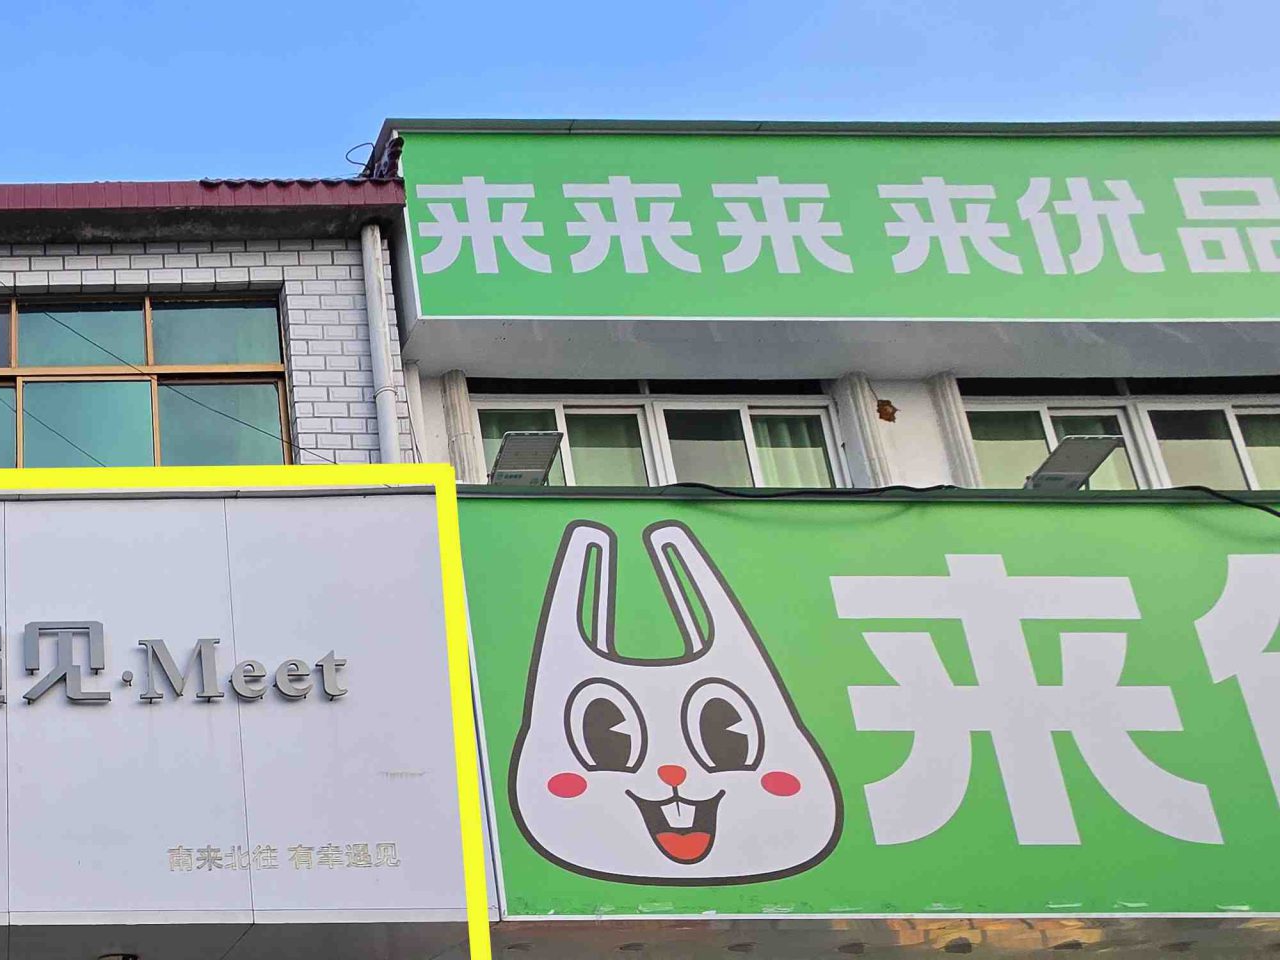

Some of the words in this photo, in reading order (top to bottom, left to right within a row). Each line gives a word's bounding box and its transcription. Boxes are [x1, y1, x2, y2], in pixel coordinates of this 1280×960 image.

[416, 175, 854, 275] 来来来
[877, 175, 1280, 275] 来优品
[167, 844, 279, 871] 南来北往
[287, 842, 401, 870] 有幸遇见
